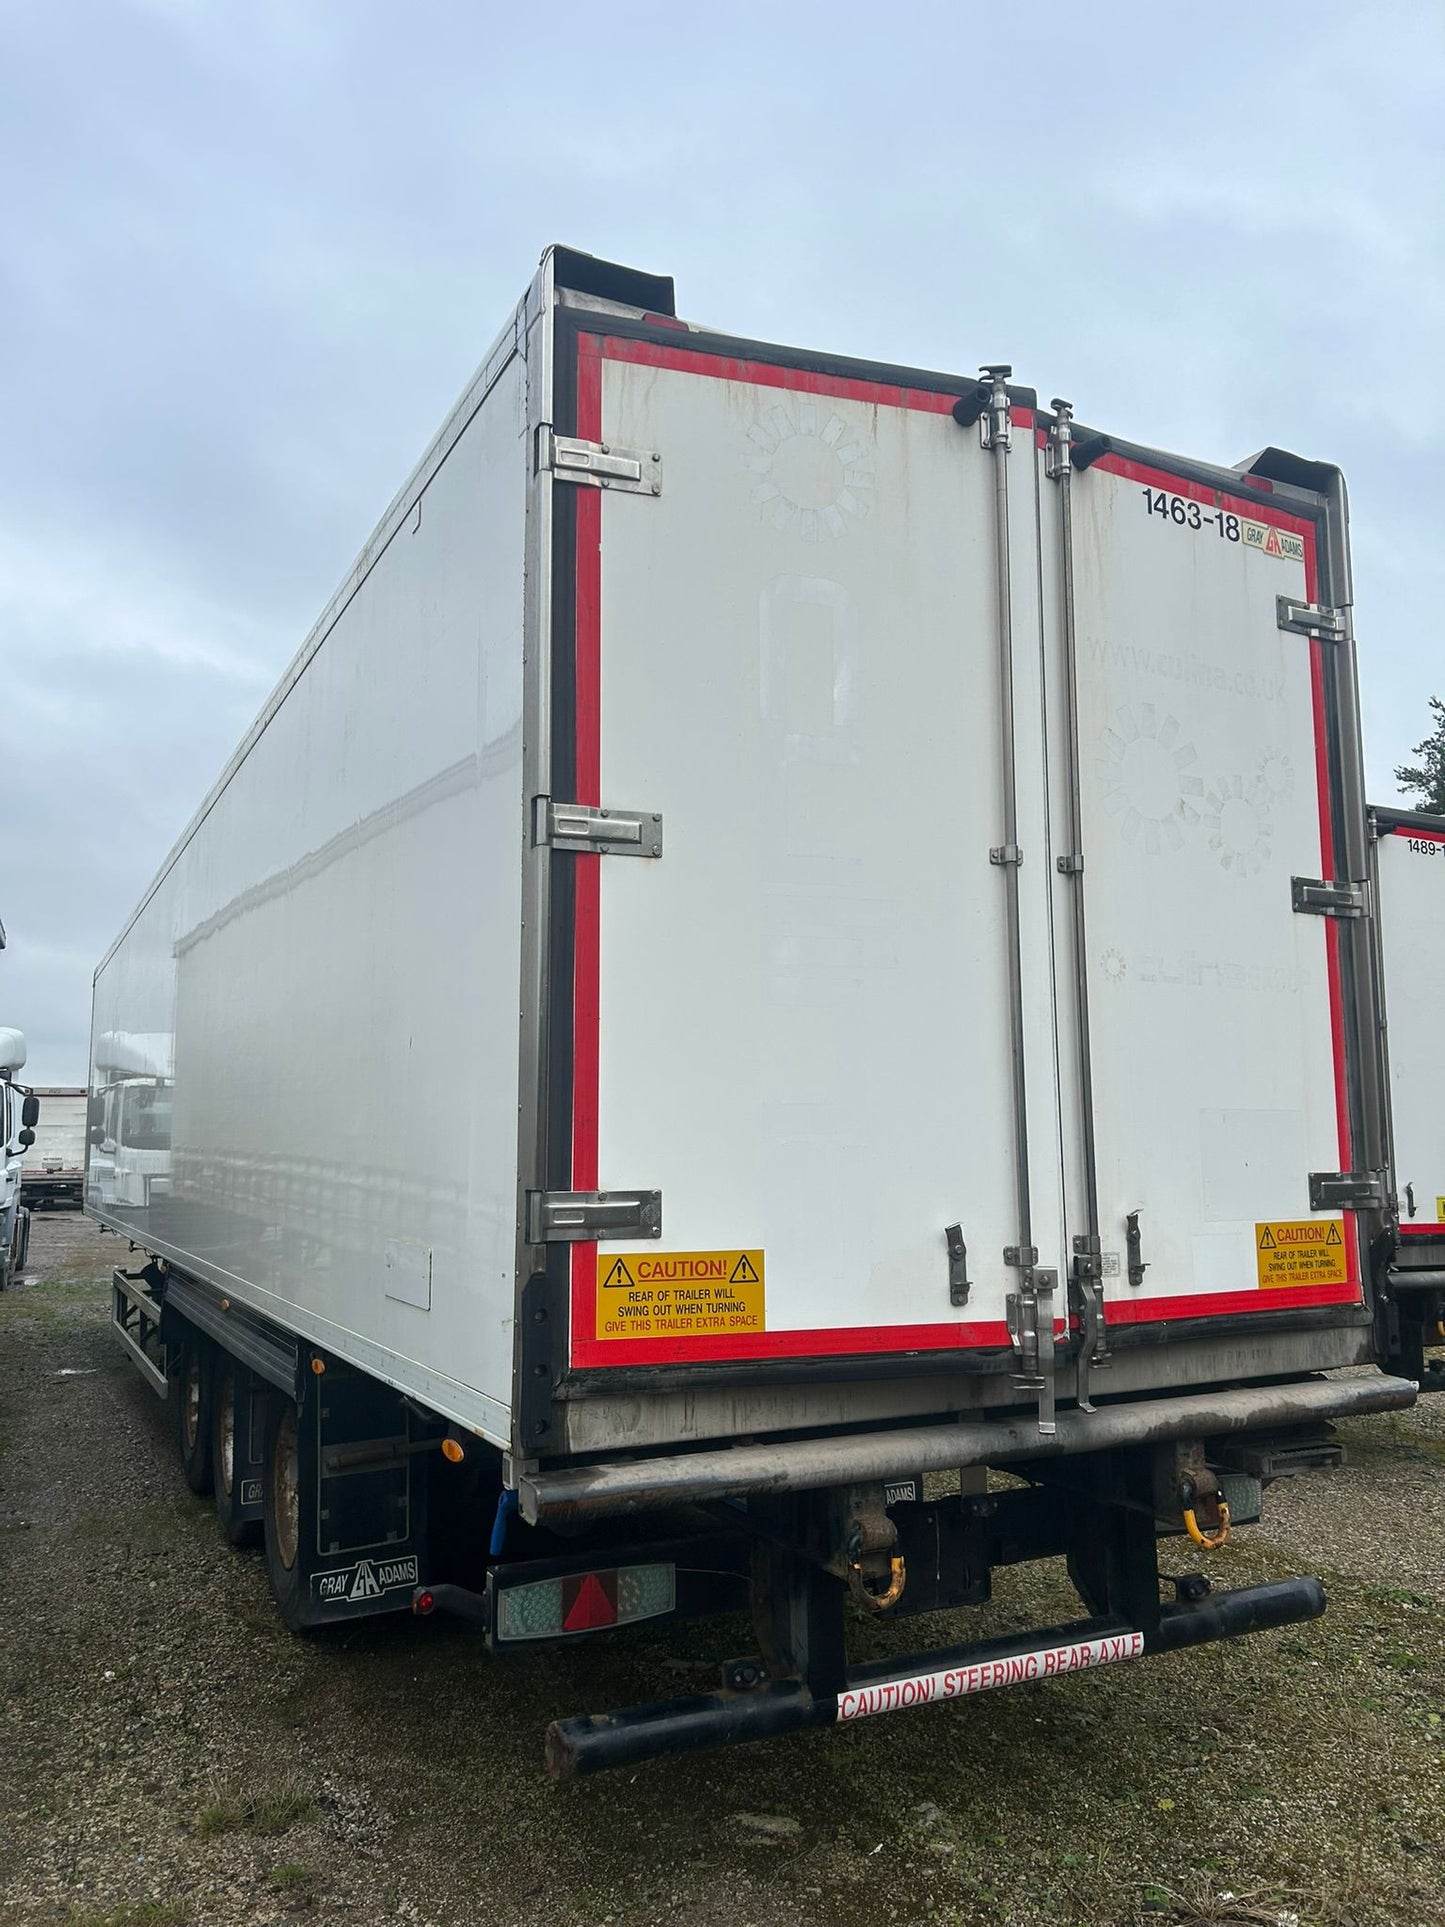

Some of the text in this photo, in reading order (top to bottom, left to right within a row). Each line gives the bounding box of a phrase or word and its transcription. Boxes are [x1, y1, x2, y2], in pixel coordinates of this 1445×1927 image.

[1142, 488, 1240, 542] 1463-18
[1246, 527, 1264, 544] GRAY
[1281, 539, 1303, 557] ADAMS
[1277, 1227, 1325, 1241] CAUTION!
[1273, 1249, 1329, 1260] REAR OF TRAILER WILL
[637, 1260, 727, 1278] CAUTION!
[1268, 1259, 1335, 1271] SWING OUT WHEN TURNING
[1262, 1269, 1342, 1283] GIVE THIS TRAILER EXTRA SPACE
[629, 1288, 735, 1302] REAR OF TRAILER WILL
[618, 1302, 745, 1317] SWING OUT WHEN TURNING
[605, 1315, 758, 1332] GIVE THIS TRAILER EXTRA SPACE
[886, 1487, 914, 1504] ADAMS
[320, 1574, 349, 1595] GRAY
[380, 1562, 416, 1585] ADAMS
[840, 1634, 1142, 1720] CAUTION! STEERING REAR AXLE
